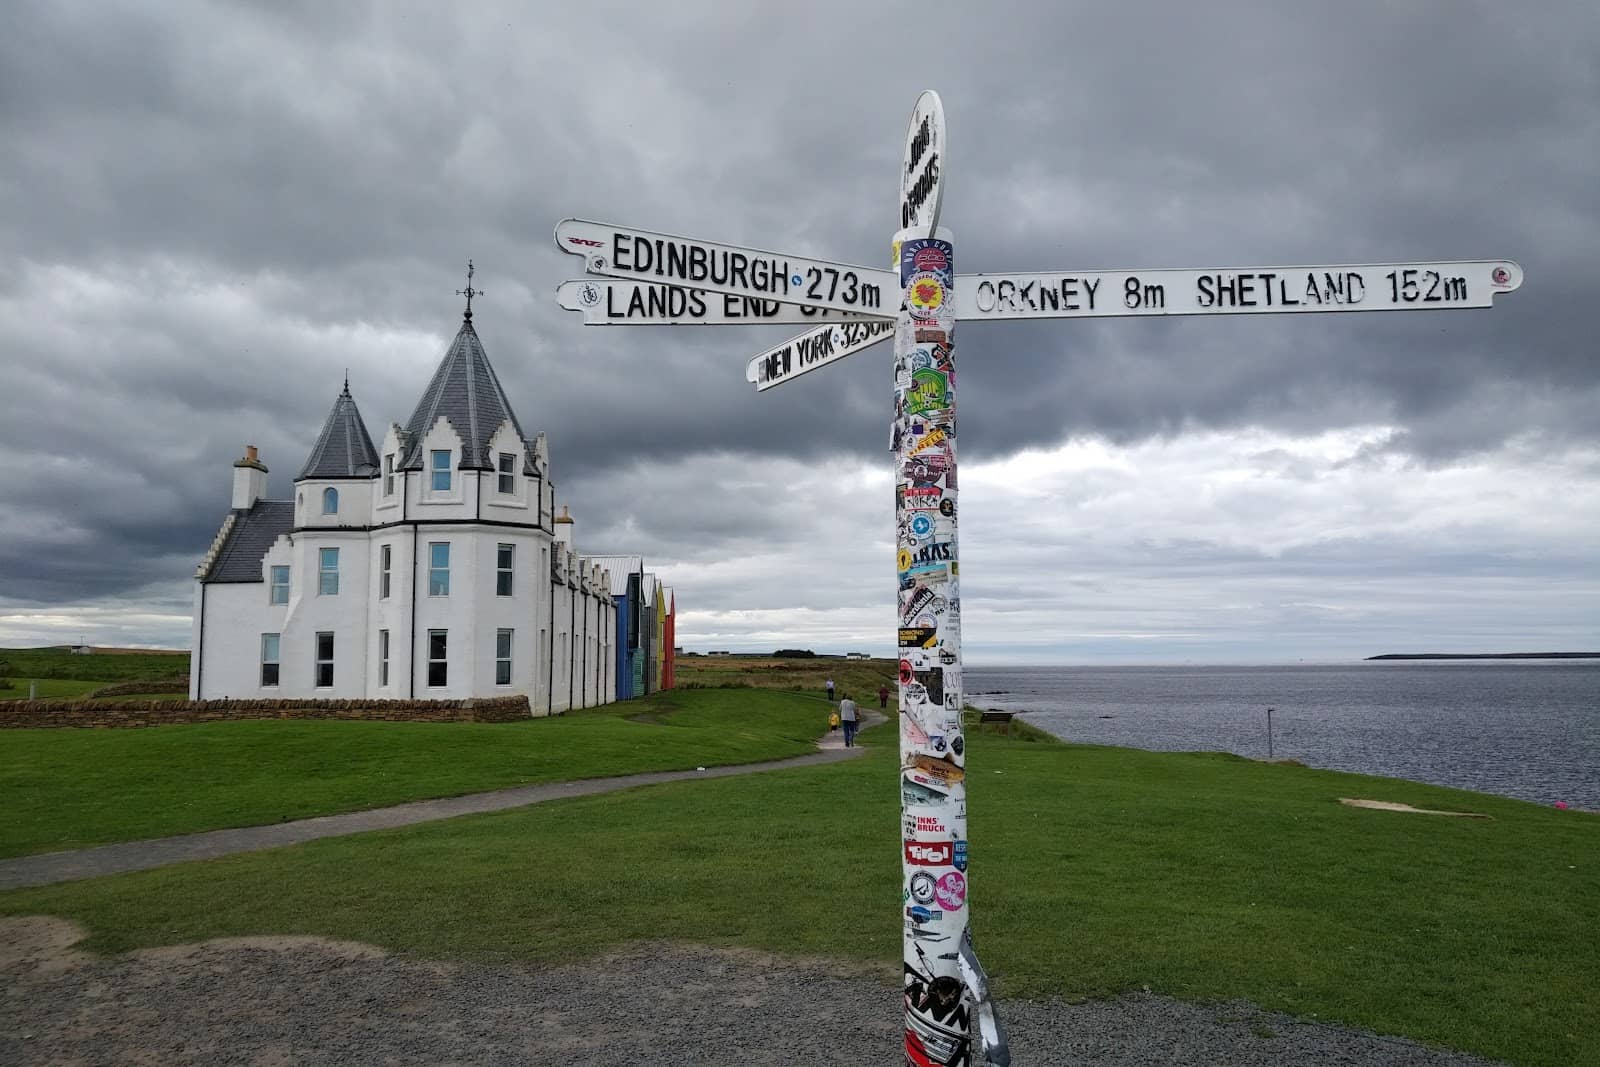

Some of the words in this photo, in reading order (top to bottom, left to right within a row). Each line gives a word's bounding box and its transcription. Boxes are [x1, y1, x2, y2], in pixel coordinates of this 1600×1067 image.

[613, 233, 788, 295] EDINBURGH
[806, 266, 880, 308] 273m
[607, 286, 706, 318] LANDS
[724, 294, 780, 318] END
[976, 277, 1100, 312] ORKNEY
[1124, 276, 1165, 308] 8m
[1197, 272, 1364, 307] SHETLAND
[1386, 270, 1467, 303] 152m
[765, 345, 791, 382] NEW
[796, 326, 835, 368] YORK
[917, 824, 945, 832] BRUCK
[908, 845, 949, 862] Tirol
